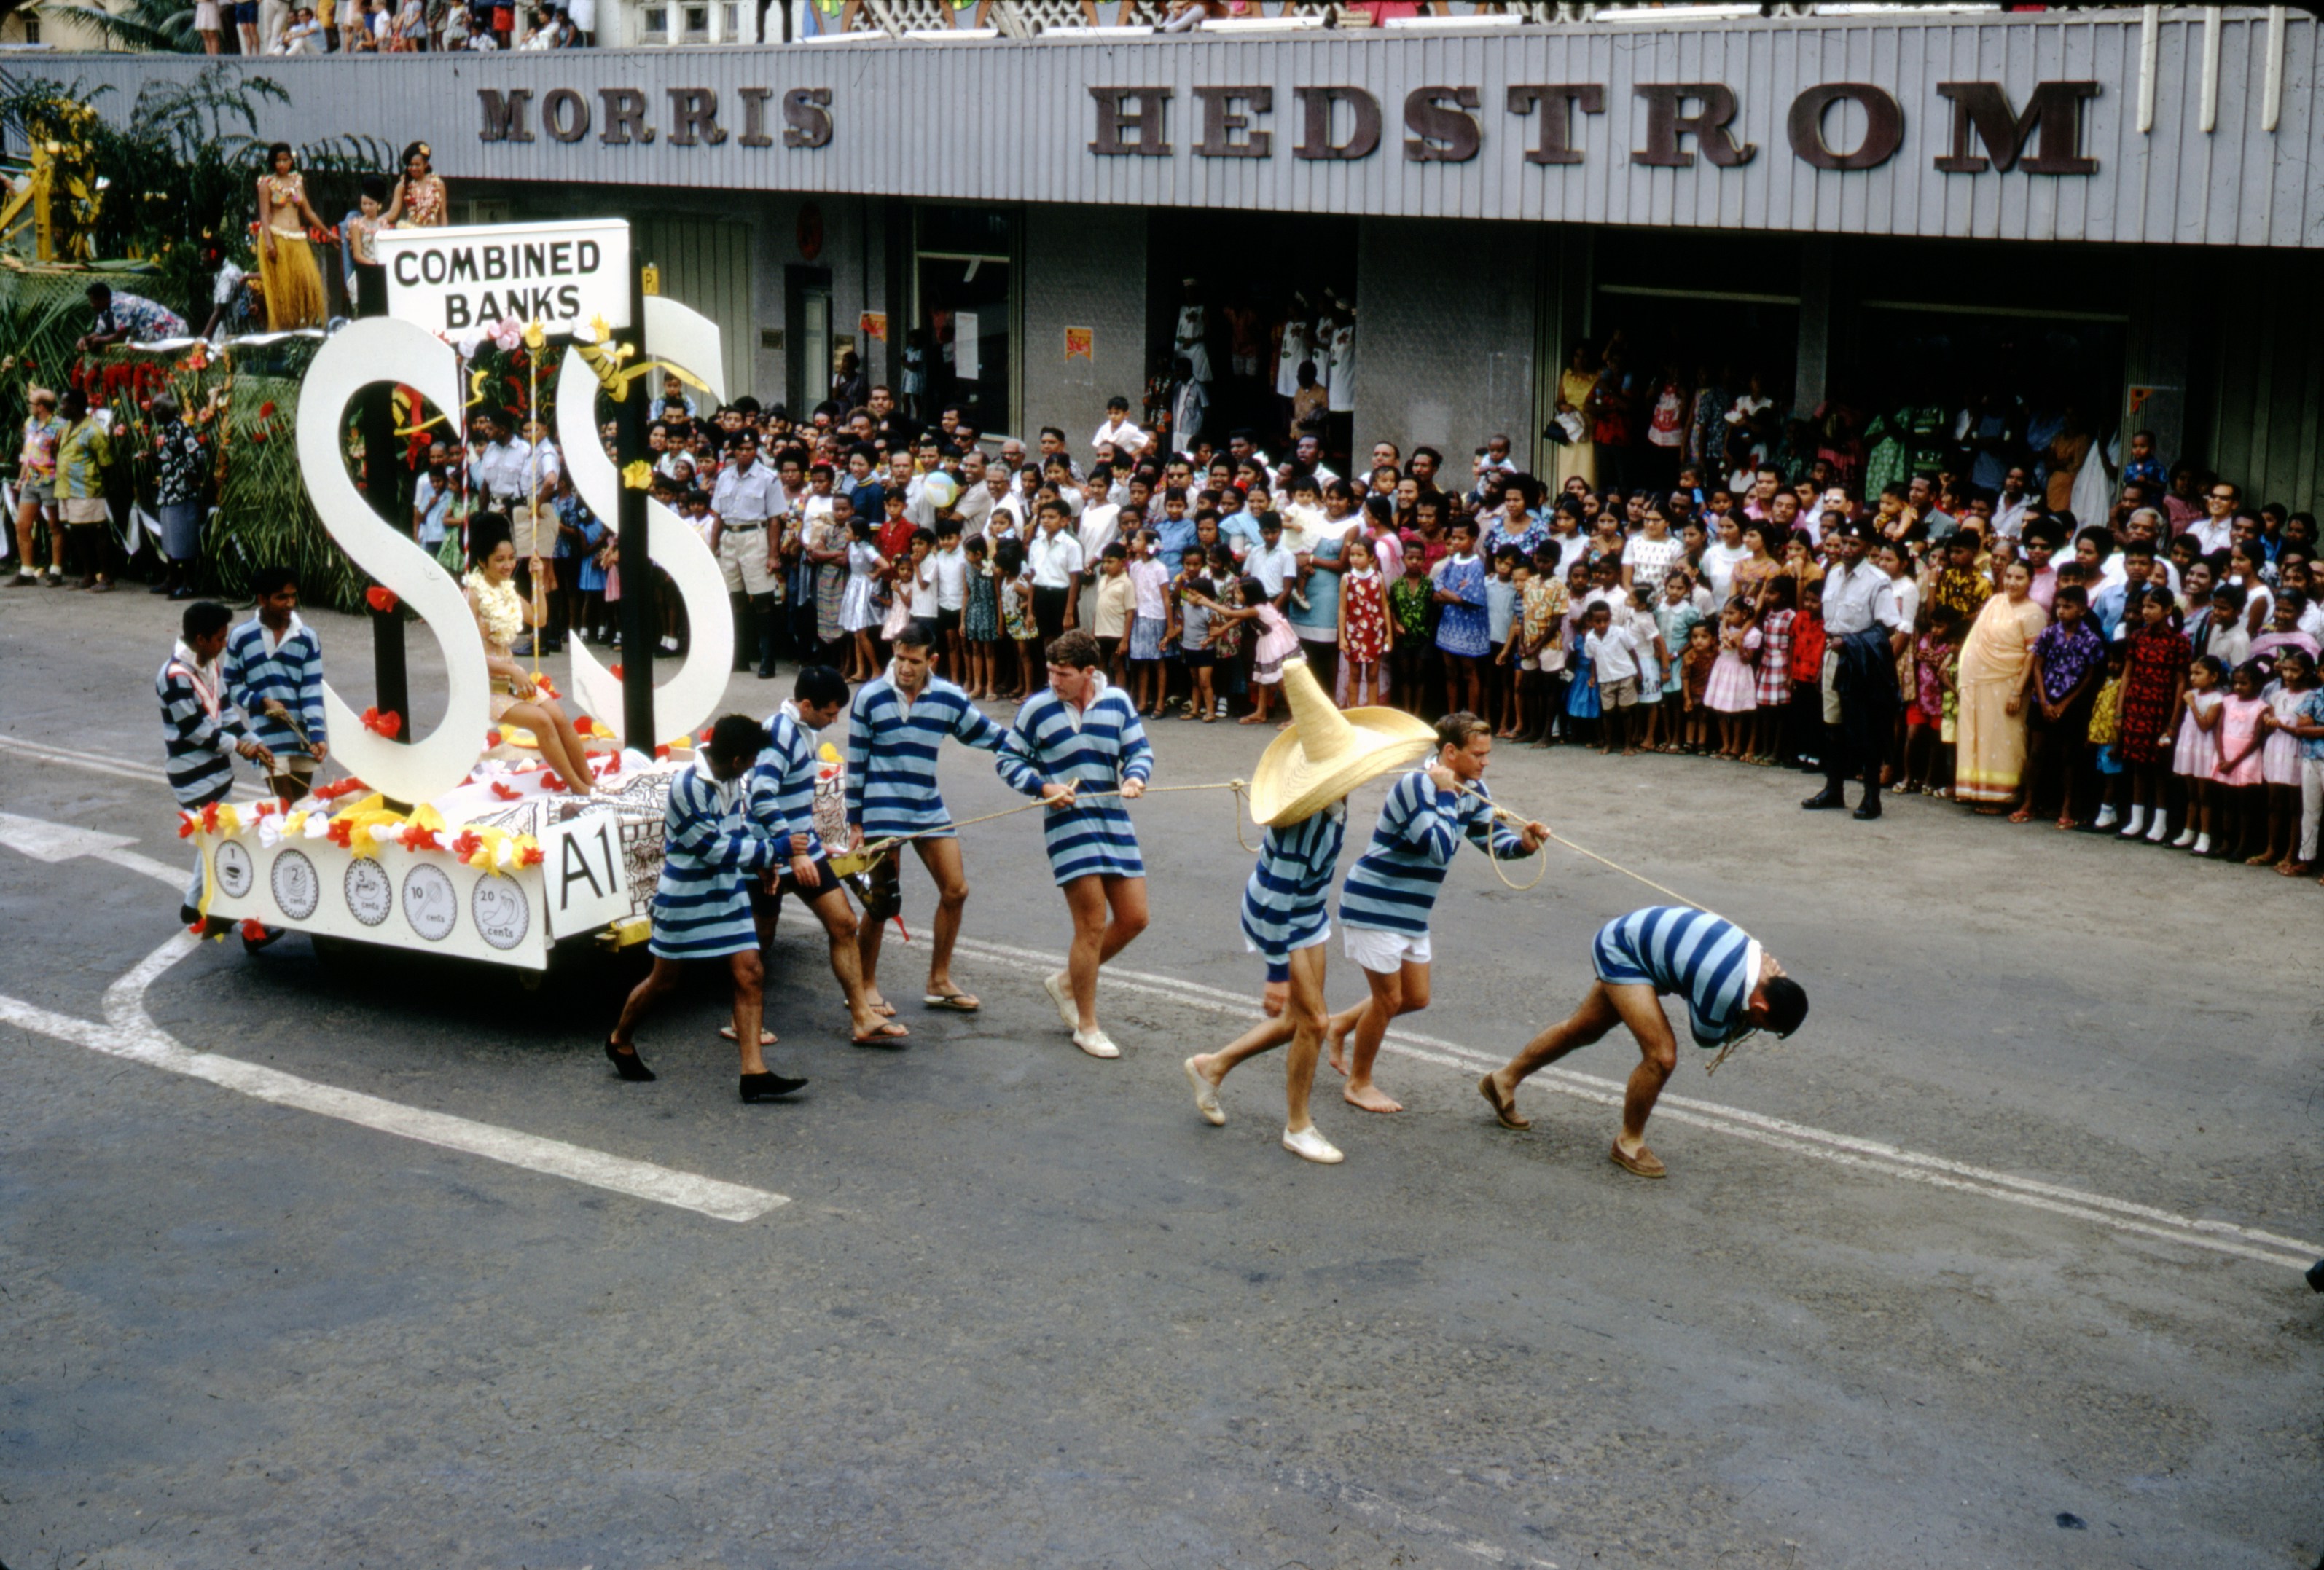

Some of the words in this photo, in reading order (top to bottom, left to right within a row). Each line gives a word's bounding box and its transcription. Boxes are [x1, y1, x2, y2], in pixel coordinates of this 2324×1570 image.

[477, 87, 832, 148] MORRIS
[1087, 81, 2101, 176] HEDSTROM
[394, 240, 601, 287] COMBINED
[445, 285, 581, 329] BANKS
[230, 847, 235, 859] 1
[560, 822, 617, 911] A1
[292, 868, 299, 881] 2
[358, 871, 366, 882] 5
[411, 887, 423, 899] 10
[480, 890, 495, 901] 20
[361, 901, 379, 911] cents
[426, 914, 445, 923] cents
[487, 927, 513, 938] cents
